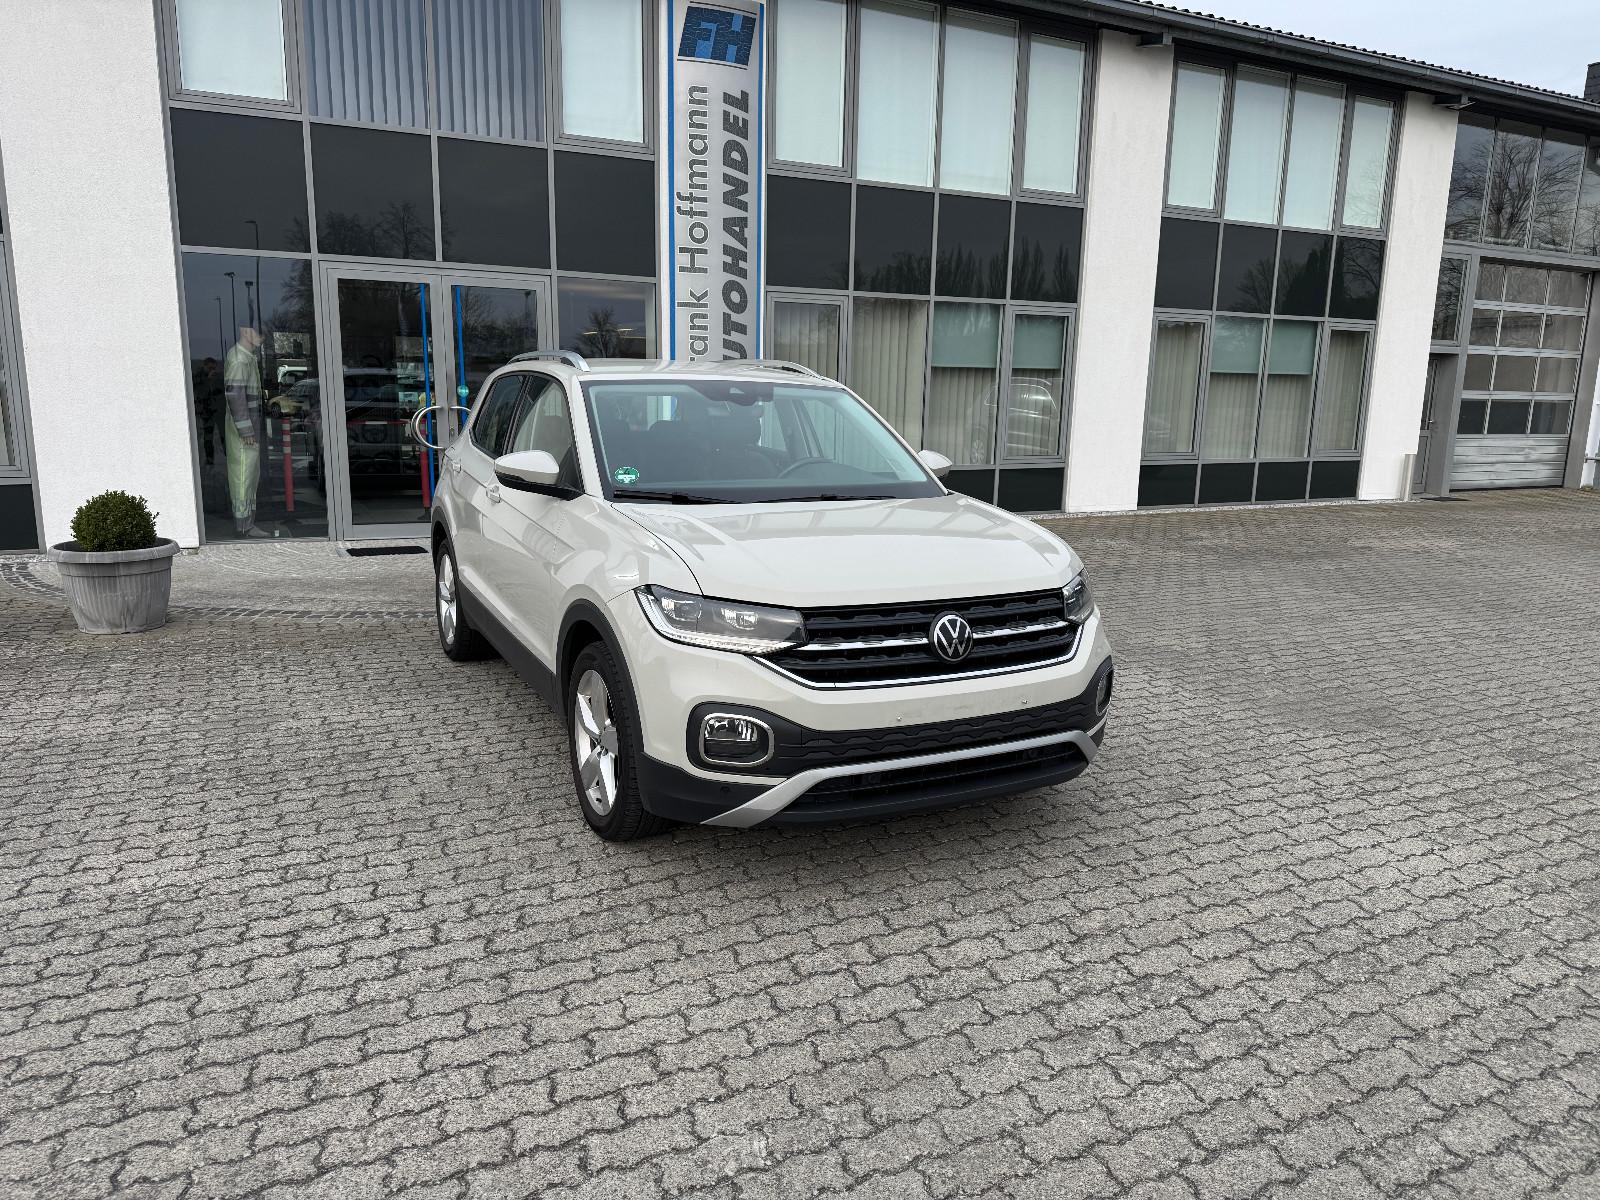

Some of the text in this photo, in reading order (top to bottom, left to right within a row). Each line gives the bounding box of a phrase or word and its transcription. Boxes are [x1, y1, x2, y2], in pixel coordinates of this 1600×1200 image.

[678, 6, 756, 66] FH
[676, 86, 708, 361] ank Hoffmann
[722, 90, 749, 360] UTOHANDEL
[934, 615, 971, 660] VW
